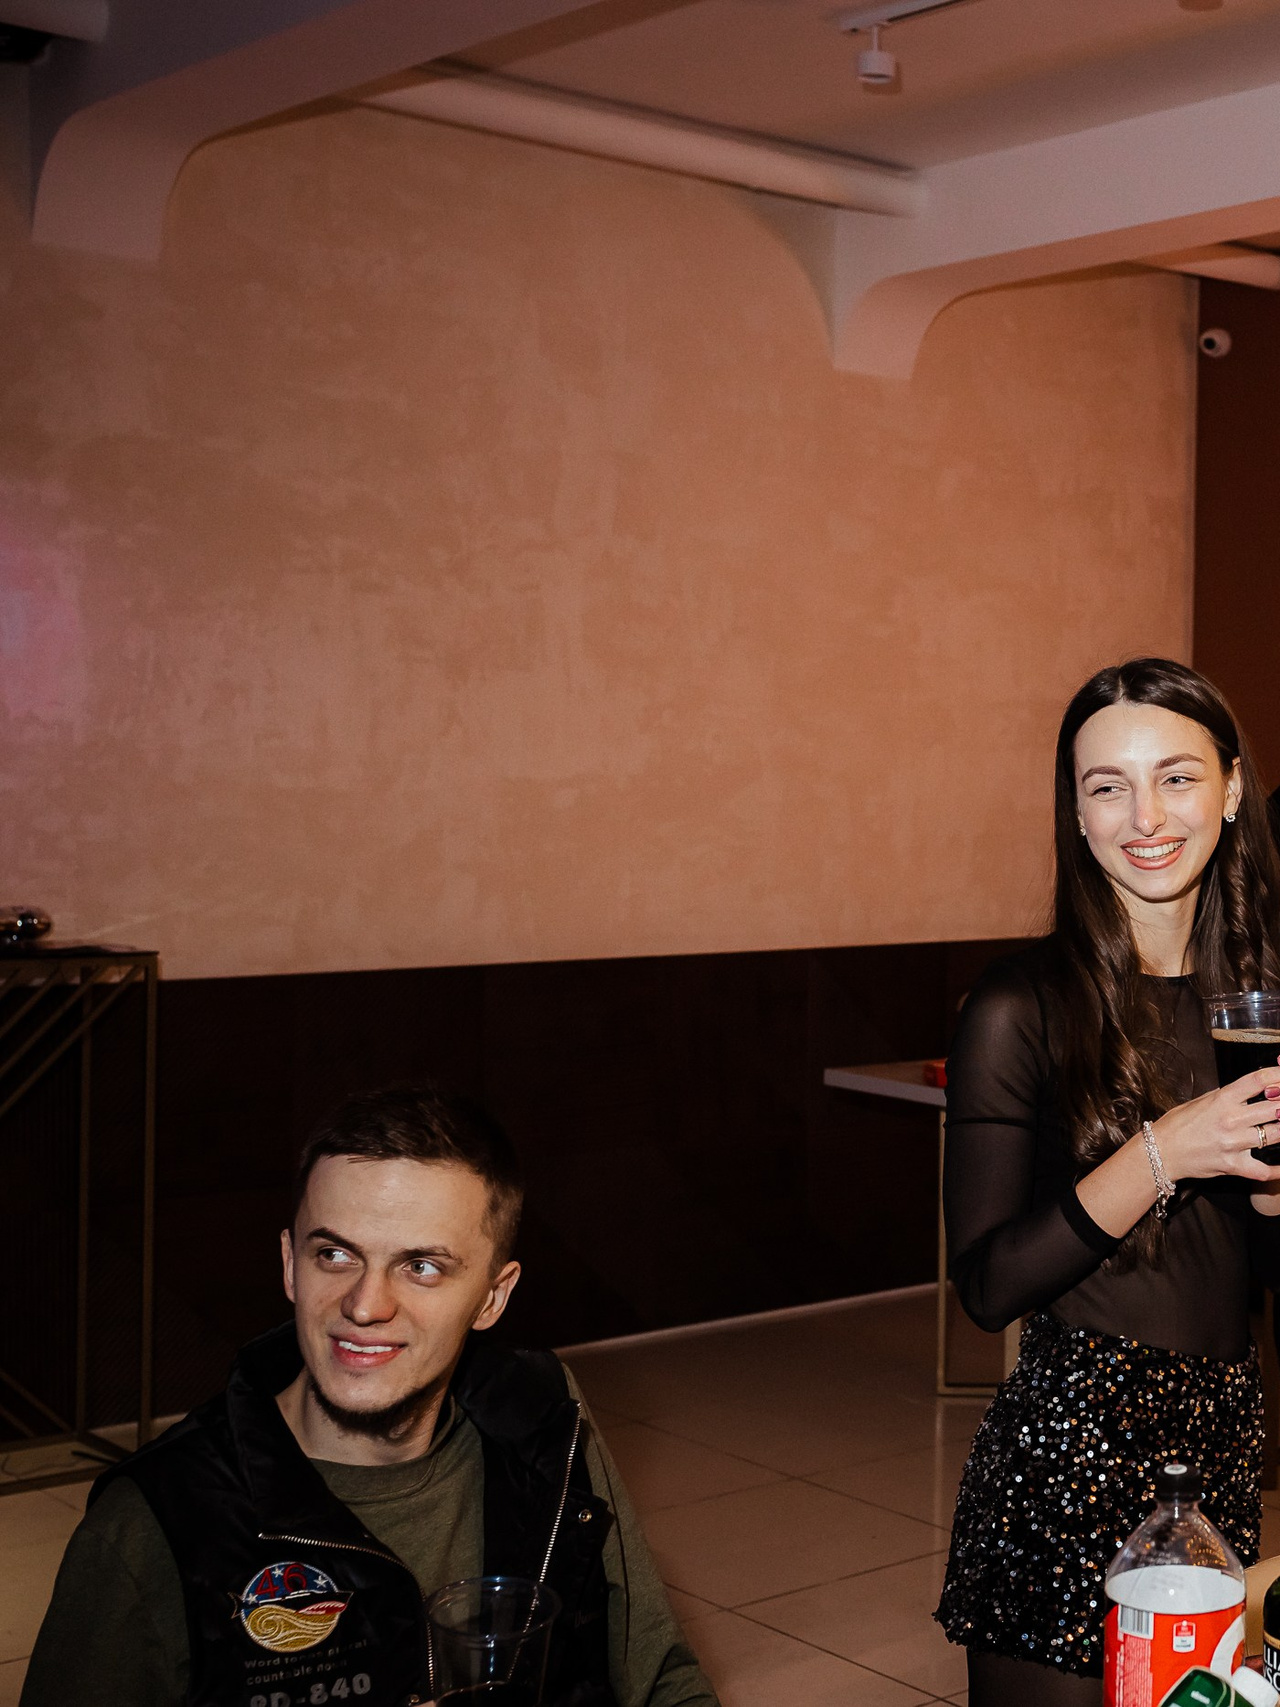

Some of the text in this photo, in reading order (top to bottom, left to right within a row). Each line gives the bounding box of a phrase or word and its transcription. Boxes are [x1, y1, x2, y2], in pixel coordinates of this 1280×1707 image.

[254, 1563, 308, 1599] 46
[244, 1656, 281, 1670] Word
[316, 1659, 348, 1673] non
